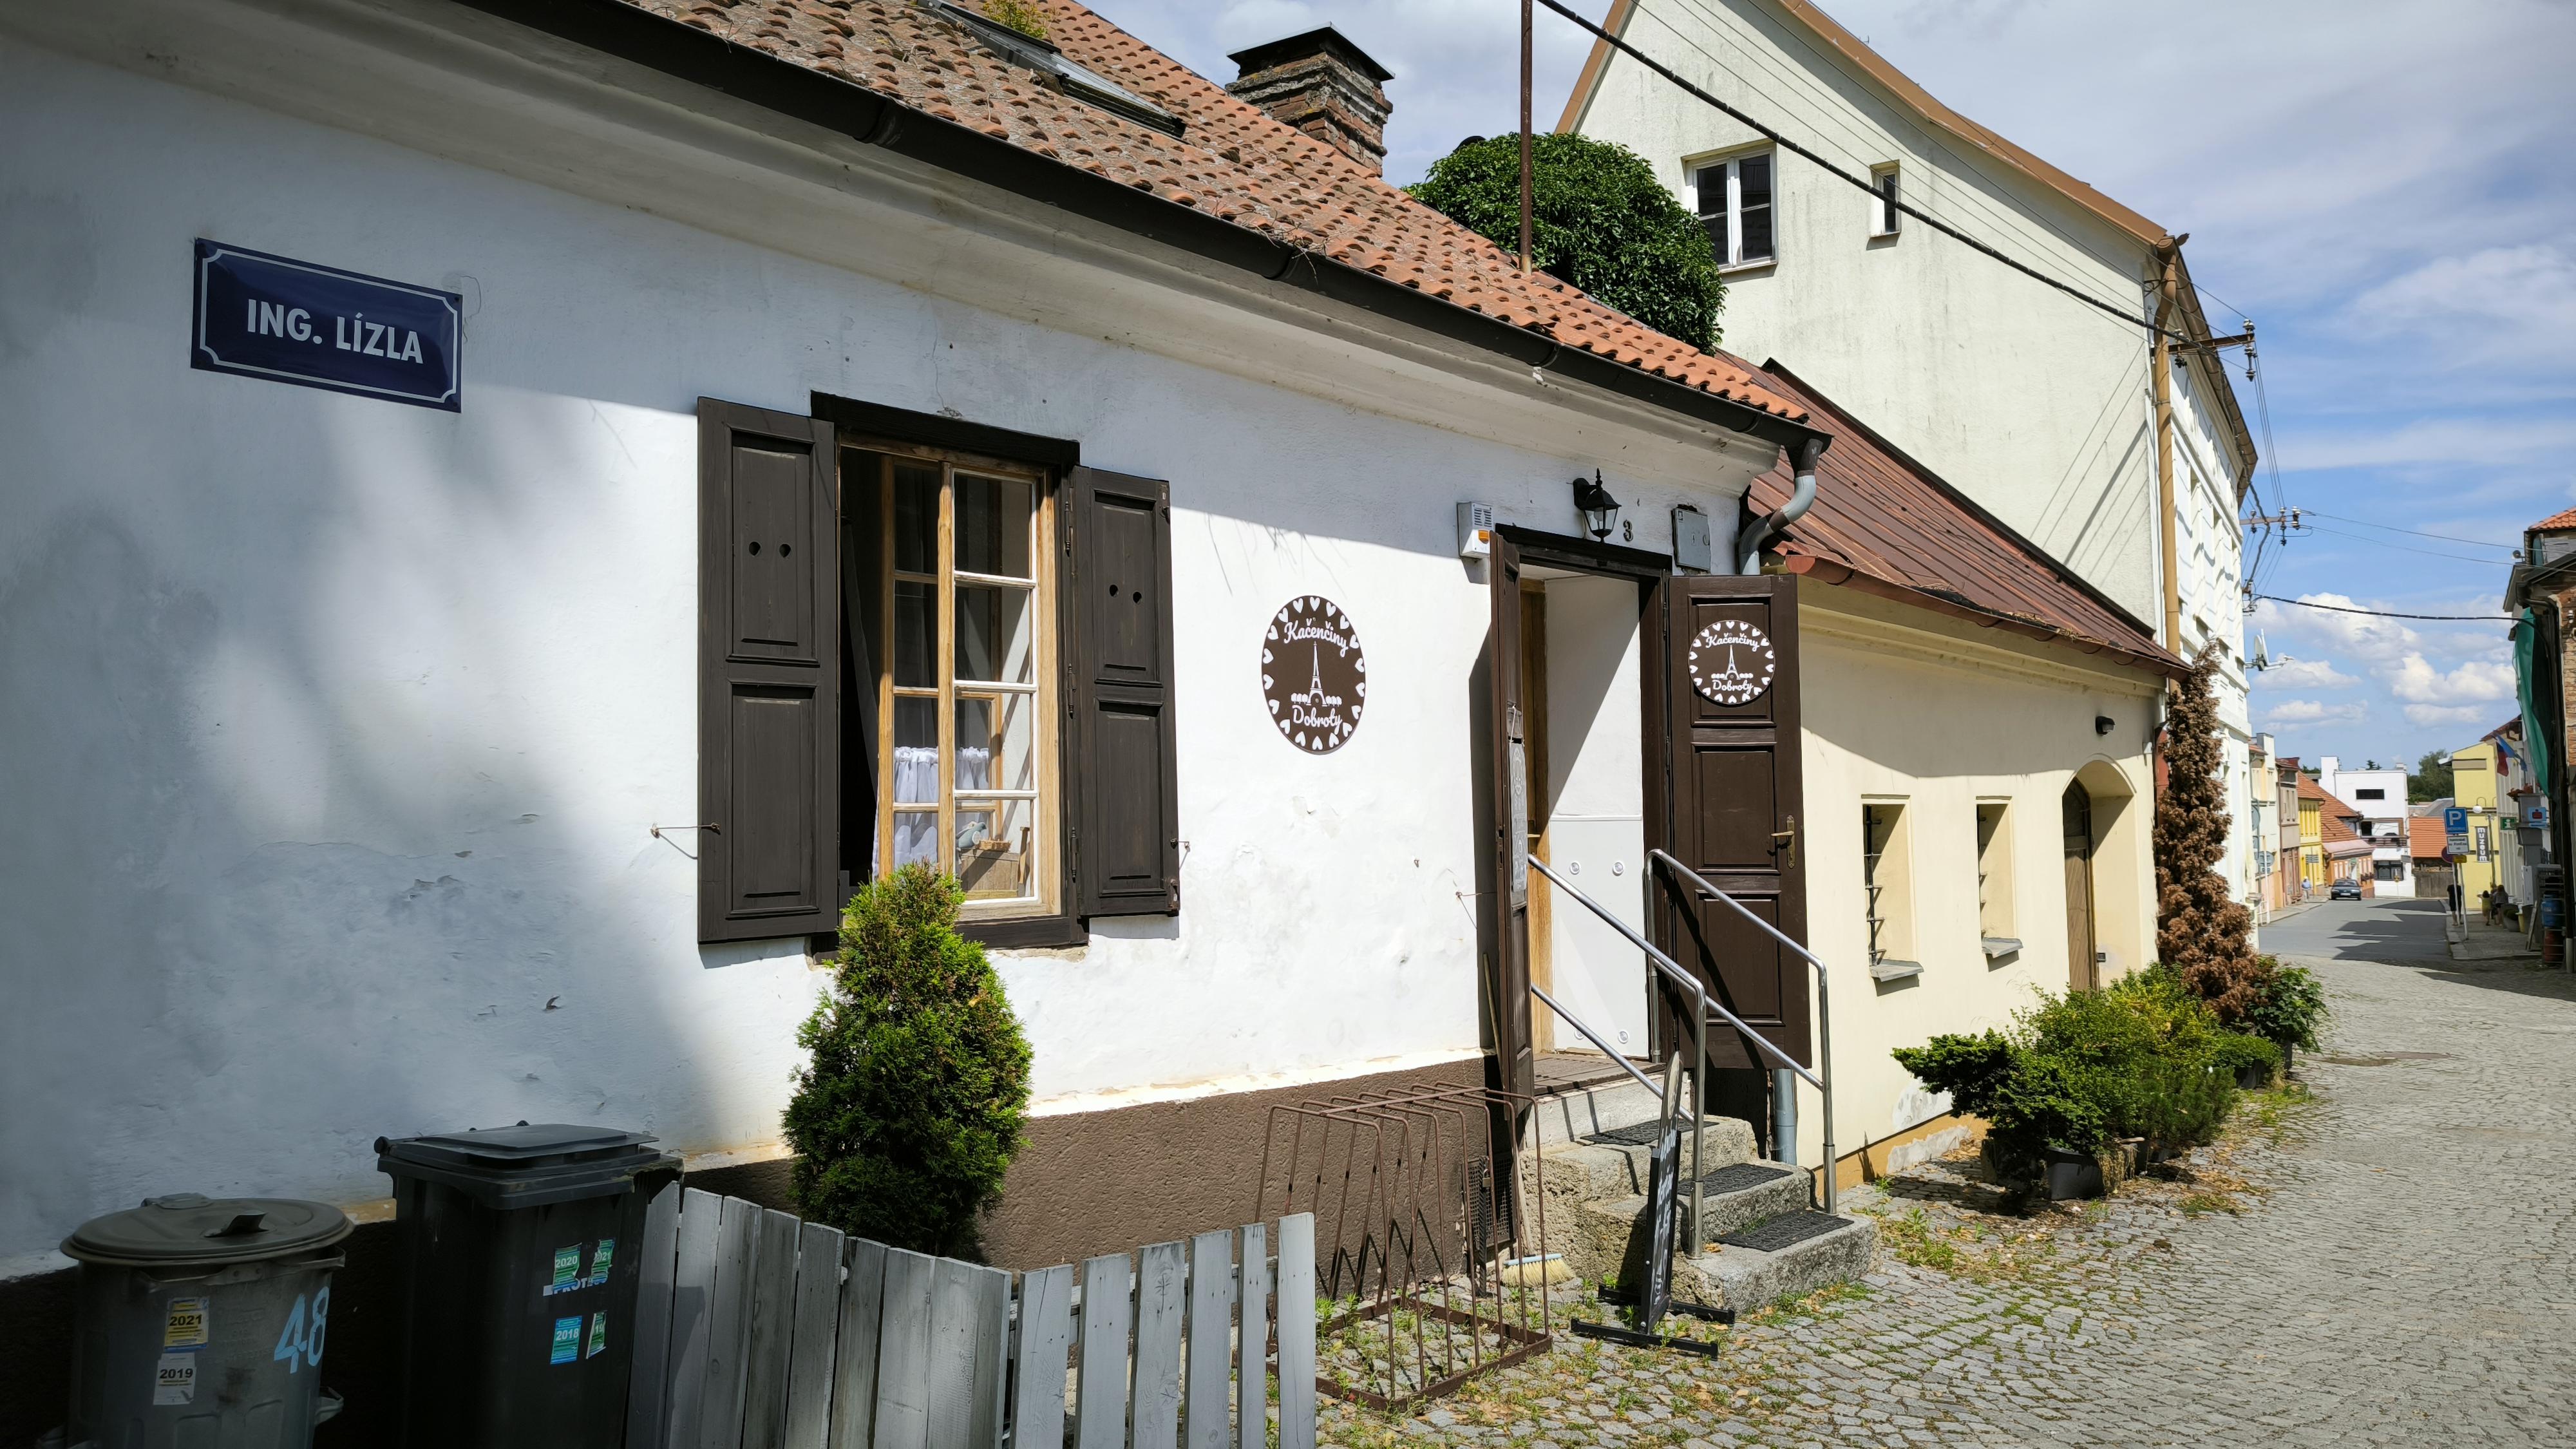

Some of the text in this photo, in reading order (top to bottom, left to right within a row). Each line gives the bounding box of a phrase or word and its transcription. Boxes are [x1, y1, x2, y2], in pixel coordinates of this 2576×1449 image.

[247, 298, 424, 365] ING. LÍZLA
[1623, 519, 1633, 542] 3
[1283, 618, 1349, 658] Kačenčiny
[1705, 632, 1759, 652] Kačenčiny
[1712, 679, 1754, 694] Dobroty
[1292, 705, 1342, 735] Dobroty
[2449, 811, 2462, 826] P
[556, 1255, 578, 1268] 2020
[593, 1251, 611, 1262] 021
[169, 1314, 203, 1327] 2021
[274, 1287, 330, 1374] 48
[556, 1328, 579, 1341] 2018
[159, 1368, 193, 1379] 2019
